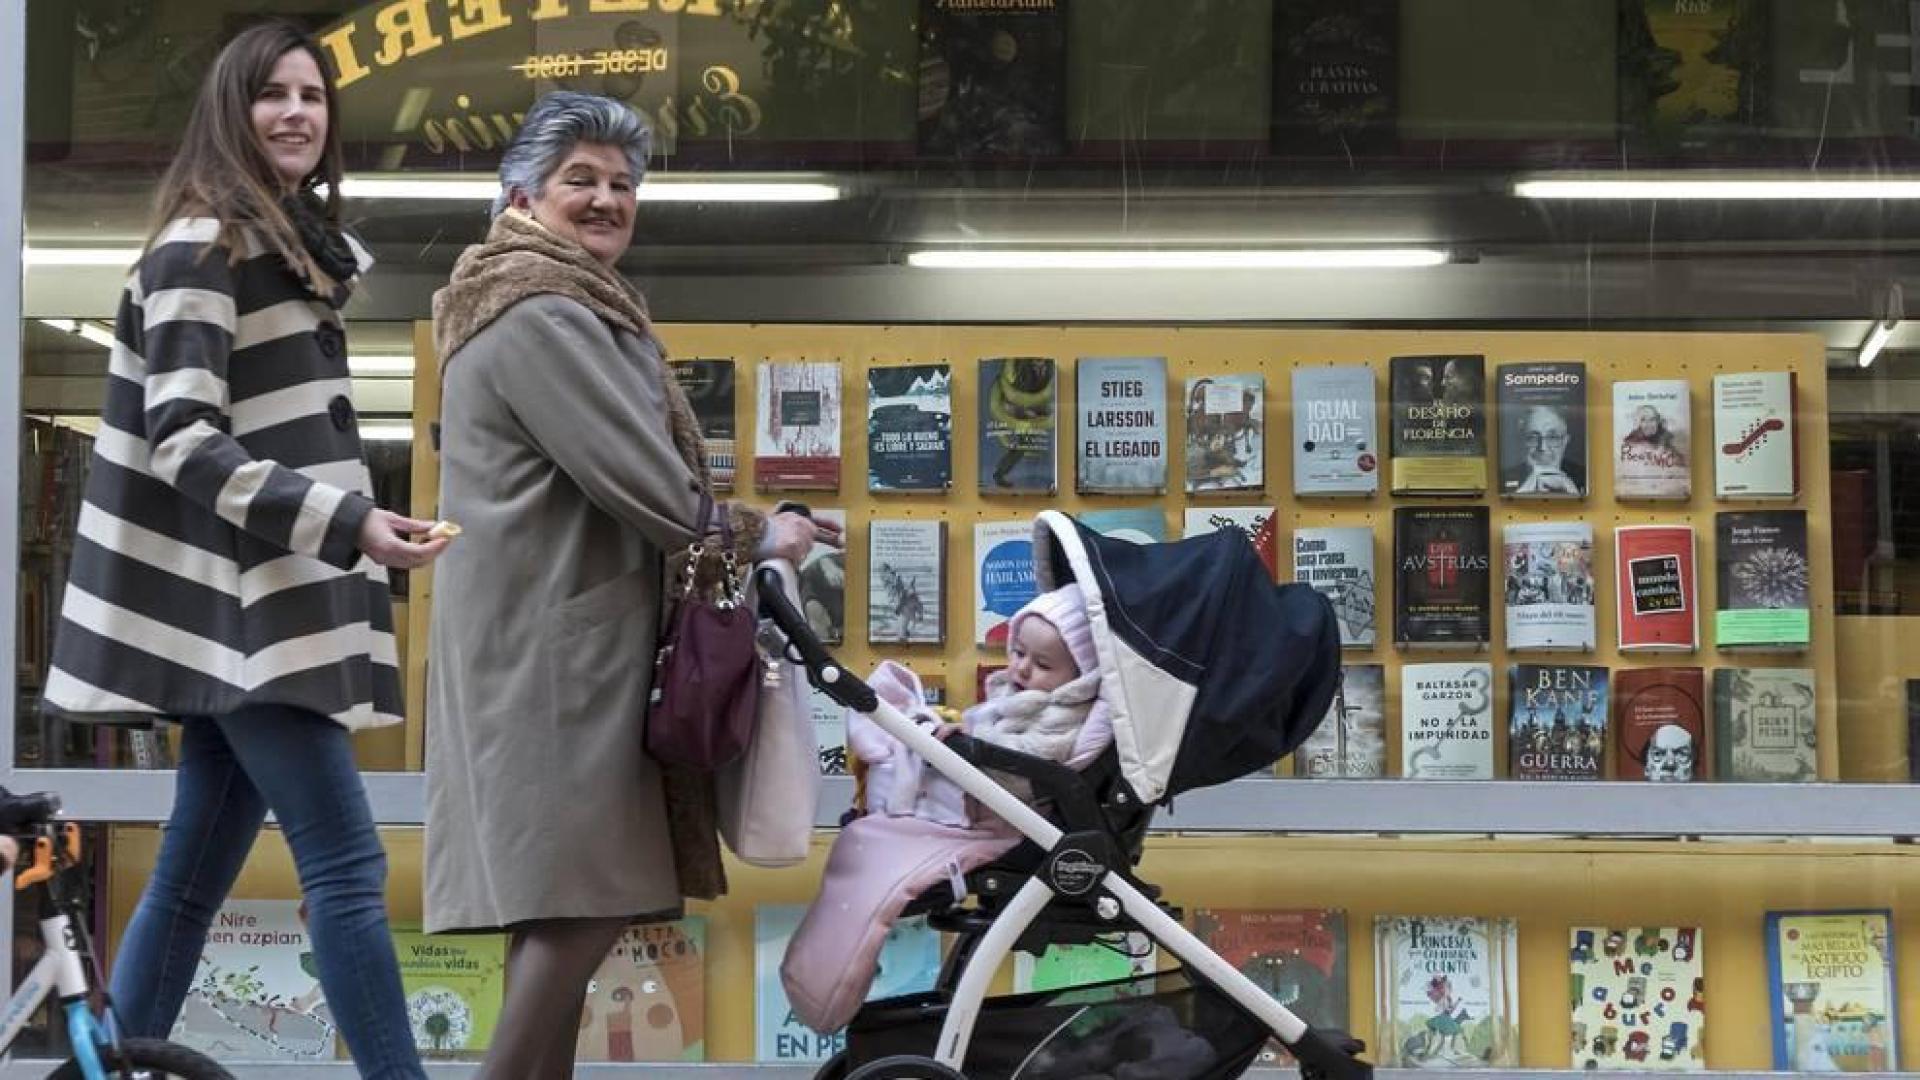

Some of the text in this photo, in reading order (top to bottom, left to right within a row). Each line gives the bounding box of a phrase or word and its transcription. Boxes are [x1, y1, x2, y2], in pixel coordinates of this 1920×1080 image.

[1504, 373, 1580, 386] Sampedro
[1101, 381, 1143, 398] STIEG
[1306, 399, 1362, 421] IGUAL
[1087, 410, 1155, 428] LARSSON
[1403, 427, 1476, 441] FLORENCIA
[1085, 441, 1161, 458] EL LEGADO
[1297, 537, 1327, 552] Como
[1319, 552, 1345, 565] rana
[1312, 567, 1358, 581] invierno
[1416, 680, 1478, 691] BALTASAR
[1539, 668, 1591, 690] BEN
[1422, 689, 1473, 700] GARZÓN
[1525, 687, 1599, 708] KANE
[1421, 718, 1478, 728] NO A LA
[1408, 730, 1490, 740] IMPUNIDAD
[1520, 753, 1598, 770] GUERRA
[220, 911, 257, 928] Nire
[240, 931, 302, 947] azpian
[410, 945, 449, 957] Vidas
[1801, 951, 1869, 965] ANTIGUO
[443, 956, 480, 970] vidas
[1807, 965, 1864, 978] EGIPTO
[776, 1034, 810, 1058] EN
